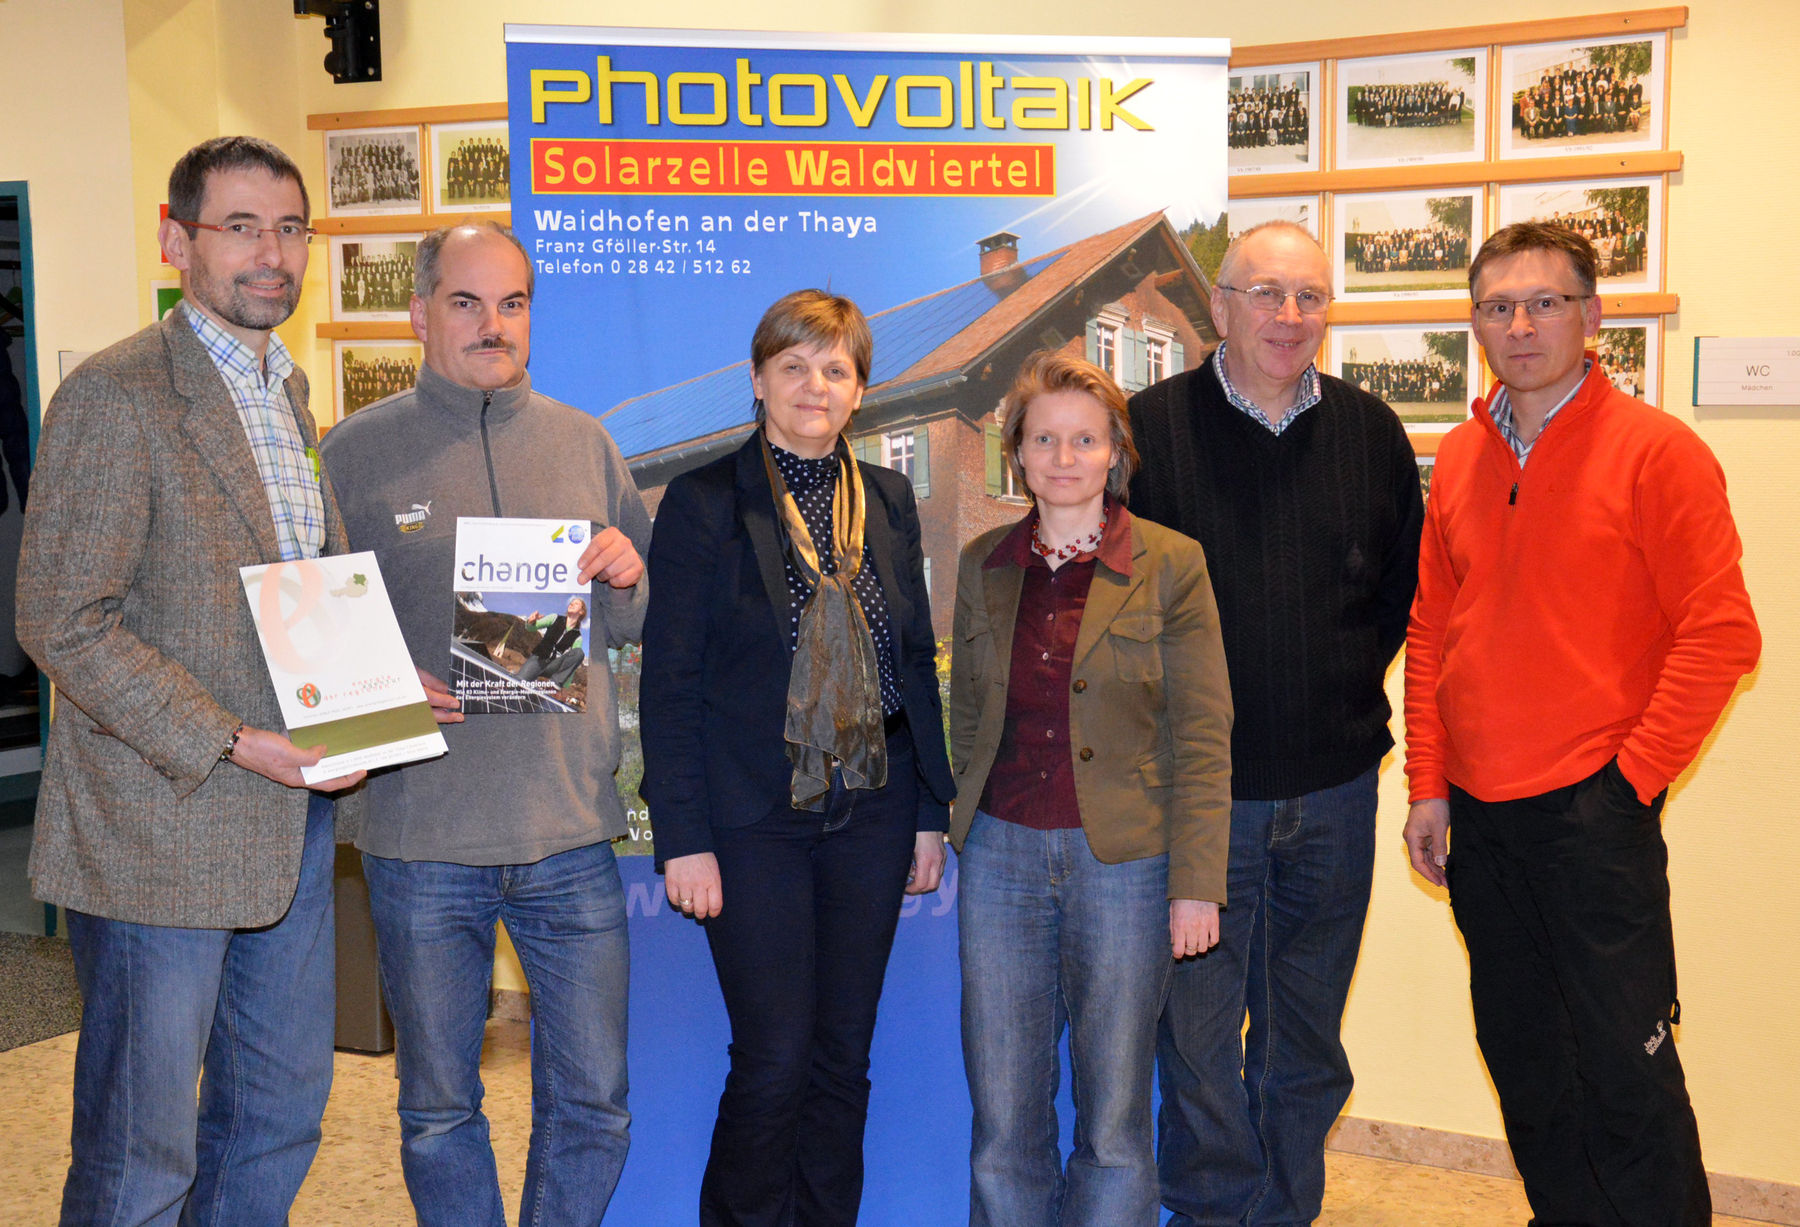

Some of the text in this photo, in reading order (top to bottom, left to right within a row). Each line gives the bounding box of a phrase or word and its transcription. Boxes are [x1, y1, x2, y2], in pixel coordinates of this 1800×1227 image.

[544, 145, 1043, 190] Solarzelle Waldviertel
[534, 209, 878, 239] Waidhofen an der Thaya
[535, 238, 587, 254] Franz
[696, 239, 717, 254] 14
[536, 259, 604, 275] Telefon
[610, 259, 621, 275] 0
[628, 259, 649, 275] 28
[654, 259, 676, 275] 42
[693, 259, 726, 275] 512
[731, 259, 752, 275] 62
[1746, 365, 1771, 377] WC
[395, 510, 426, 524] PUMA
[470, 680, 483, 688] der
[484, 680, 505, 688] Kraft
[507, 680, 519, 688] der
[522, 680, 556, 688] Regionen
